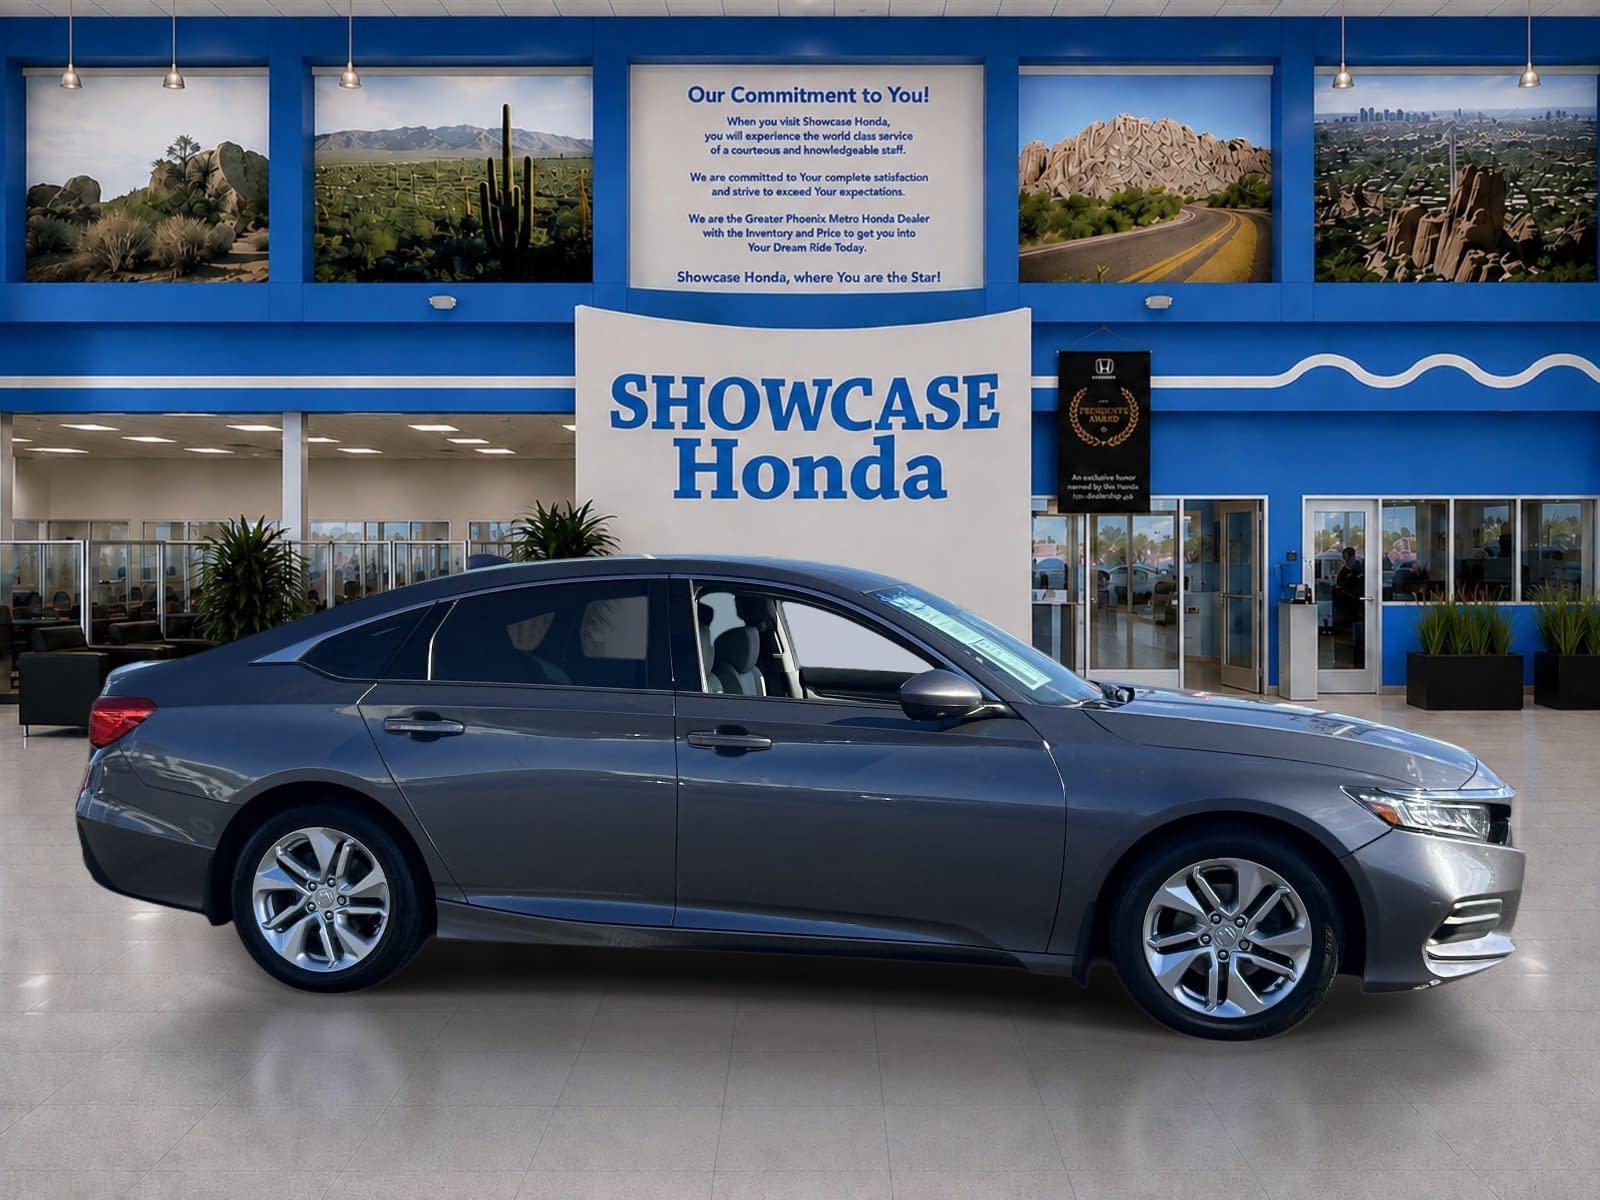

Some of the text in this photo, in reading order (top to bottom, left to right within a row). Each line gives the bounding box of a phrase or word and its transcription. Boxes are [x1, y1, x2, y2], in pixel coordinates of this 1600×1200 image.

[687, 85, 929, 104] Our Commitment to You!
[726, 115, 891, 130] When you visit Showcase Honda,
[704, 130, 914, 144] you will experience the world class service
[709, 144, 722, 156] of
[722, 147, 730, 155] a
[730, 145, 782, 155] courteous
[782, 144, 802, 156] and
[881, 144, 907, 156] staff.
[689, 171, 929, 185] We are committed to Your complete satisfaction
[711, 185, 906, 200] and strive to exceed Your expectations.
[687, 213, 931, 225] We are the Greater Phoenix Metro Honda Dealer
[702, 227, 917, 241] with the Inventory and Price to get you into
[747, 242, 868, 255] Your Dream Ride Today.
[676, 270, 941, 286] Showcase Honda, where You are the Star!
[609, 372, 1001, 432] SHOWCASE
[672, 433, 949, 501] Honda
